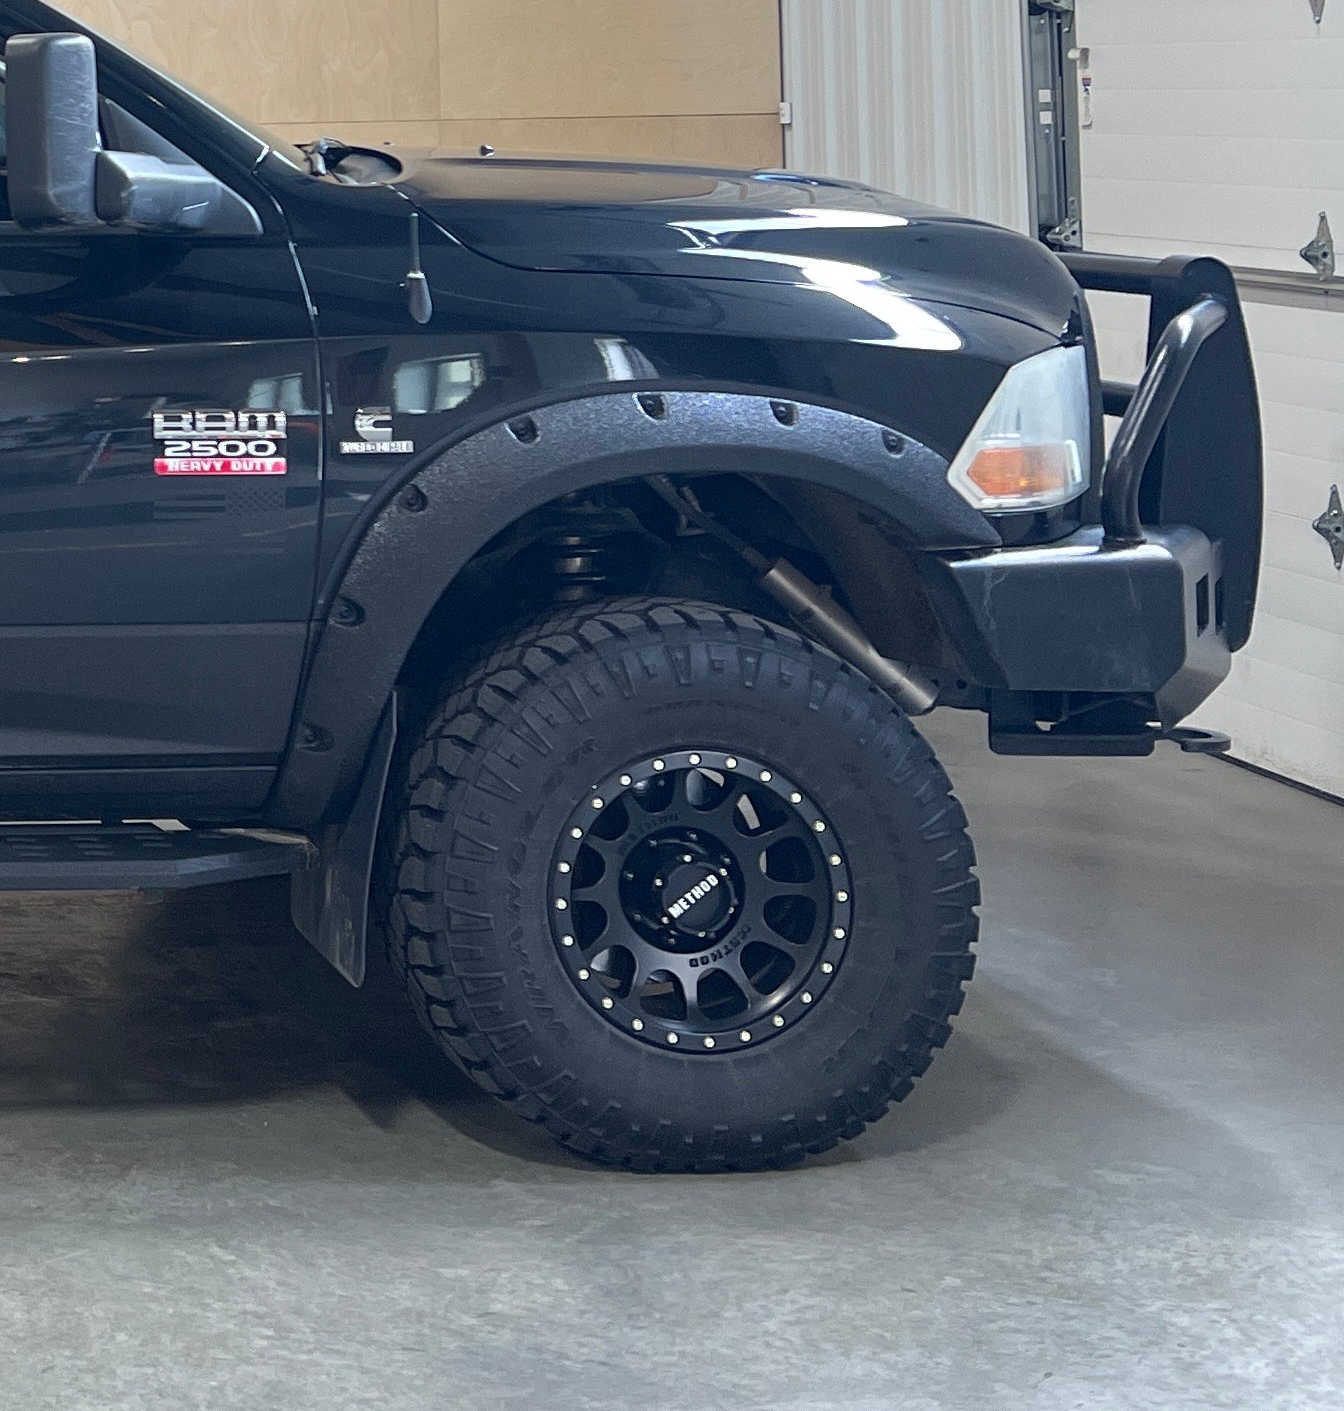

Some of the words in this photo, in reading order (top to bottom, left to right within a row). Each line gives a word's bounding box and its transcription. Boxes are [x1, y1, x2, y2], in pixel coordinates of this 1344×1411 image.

[152, 409, 287, 439] RAM
[164, 440, 277, 457] 2500
[167, 459, 224, 471] HEAVY
[231, 459, 274, 471] DUTY
[668, 874, 719, 919] METHOD
